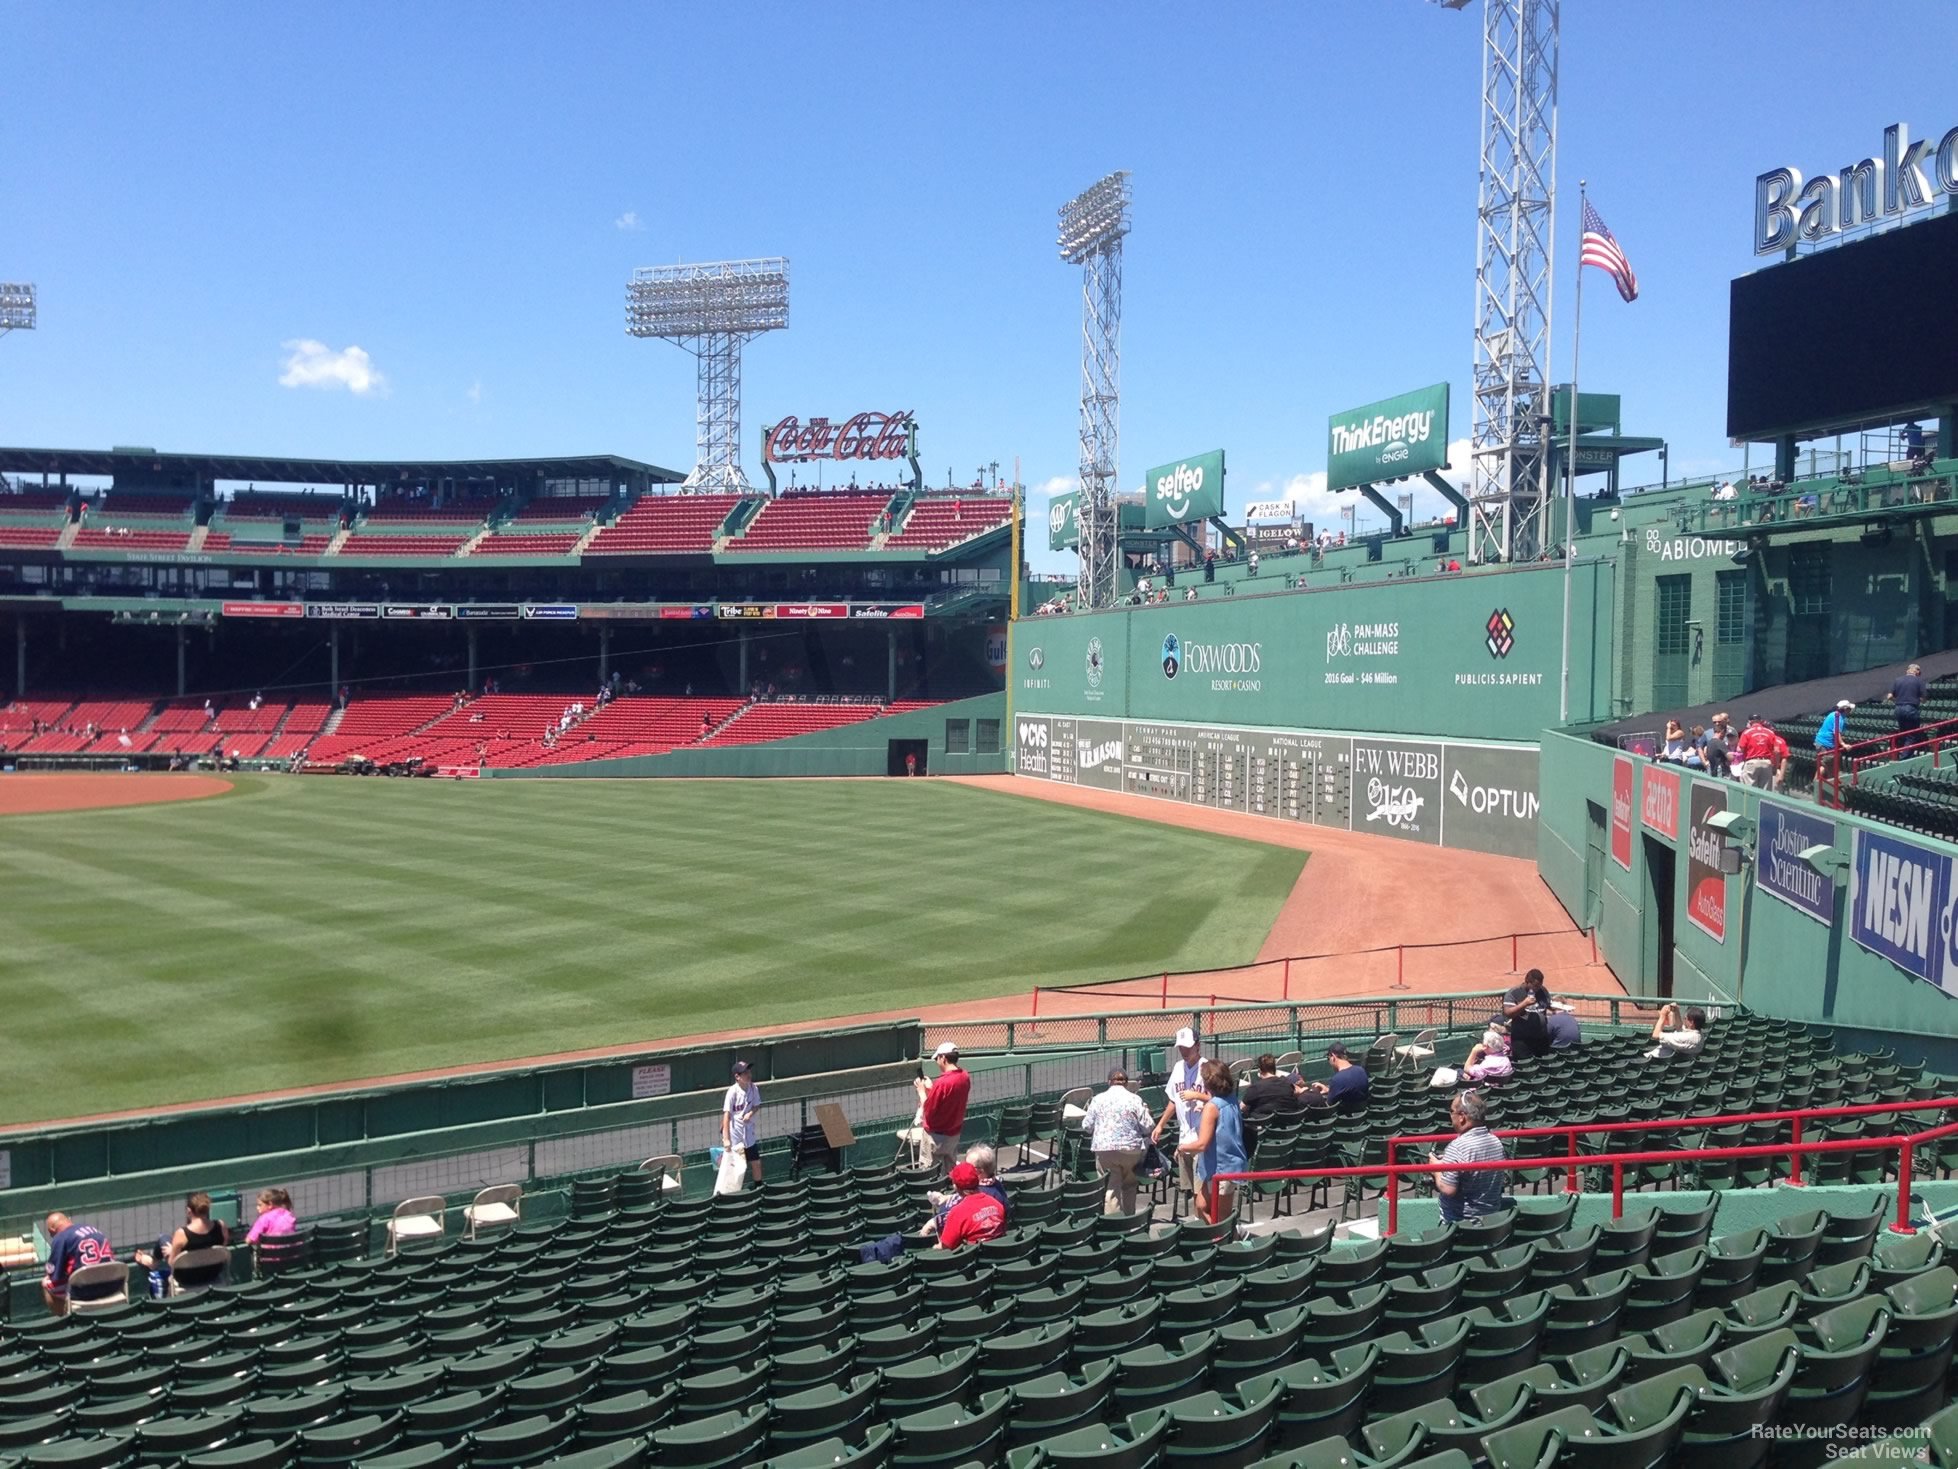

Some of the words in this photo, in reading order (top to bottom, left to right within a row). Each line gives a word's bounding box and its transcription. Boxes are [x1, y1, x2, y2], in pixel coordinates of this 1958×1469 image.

[721, 606, 742, 617] Tribe
[1354, 623, 1399, 638] PAN-MASS
[1353, 641, 1399, 656] CHALLENGE
[1023, 679, 1050, 688] INFINITI
[1211, 680, 1232, 691] RESORT
[1237, 681, 1261, 691] CASINO
[1324, 673, 1339, 684] 2016
[1340, 672, 1354, 684] Goal
[1361, 672, 1372, 684] $46
[1374, 672, 1398, 684] Million
[1455, 673, 1543, 685] PUBLICIS.SAPIENT
[1028, 723, 1048, 748] CVS
[1136, 726, 1158, 735] FENWAY
[1197, 731, 1220, 740] AMERICAN
[1222, 733, 1240, 741] LEAGUE
[1272, 737, 1298, 747] NATIONAL
[1300, 740, 1322, 748] LEAGUE
[1020, 748, 1047, 773] Health
[1355, 748, 1383, 775] F.W.
[1387, 750, 1439, 780] WEBB
[1382, 784, 1418, 826] 150
[1646, 780, 1672, 829] aetna
[1777, 812, 1810, 858] Boston
[1689, 826, 1721, 870] Safelit
[1697, 889, 1723, 927] AutoGlass
[1865, 848, 1934, 959] NESN
